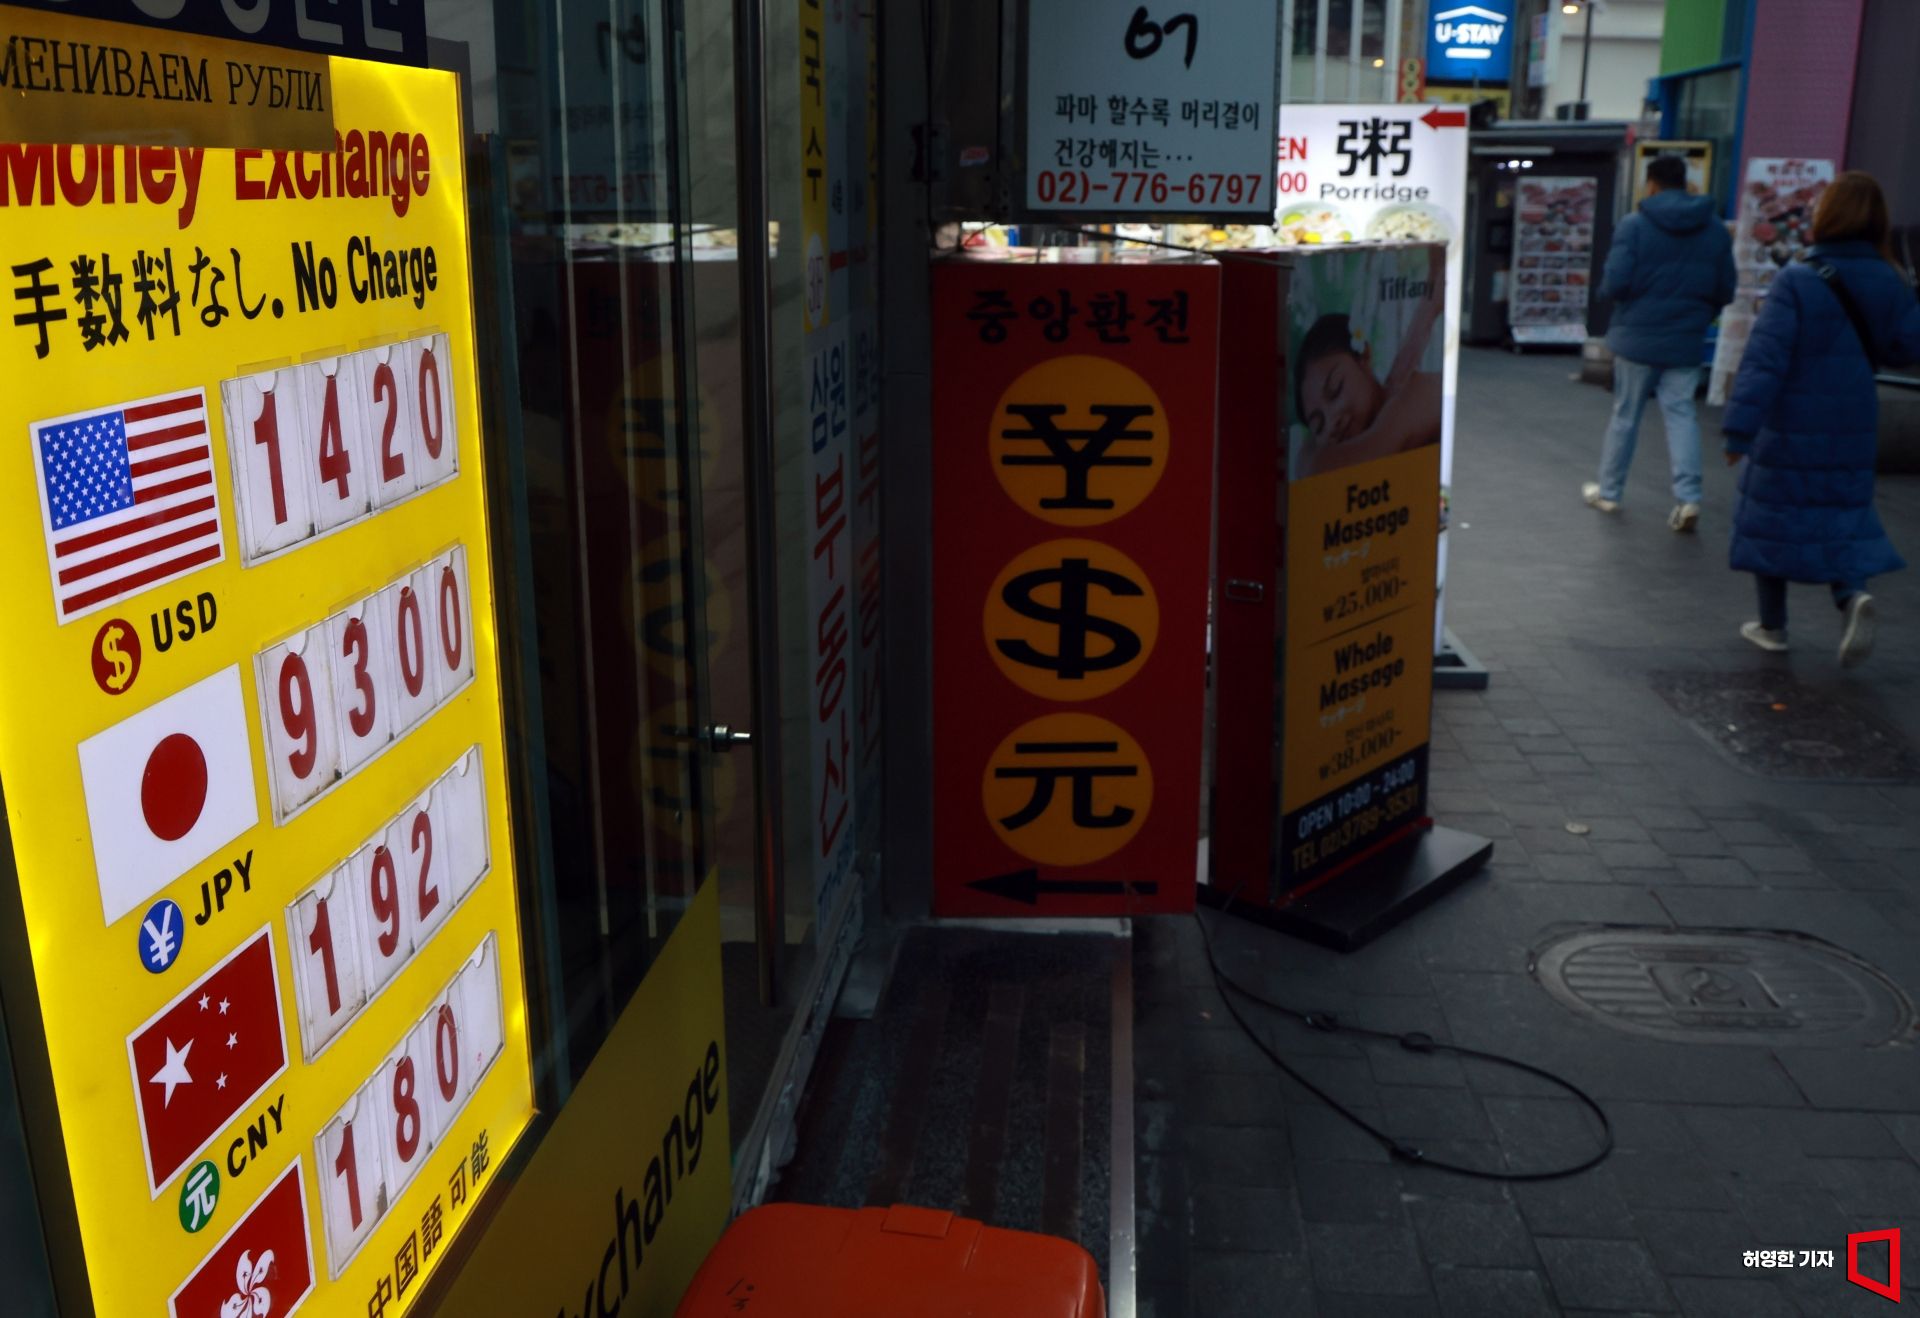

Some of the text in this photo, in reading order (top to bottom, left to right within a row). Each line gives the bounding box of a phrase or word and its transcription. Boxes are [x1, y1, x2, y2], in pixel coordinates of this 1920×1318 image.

[1435, 22, 1504, 45] U-STAY
[226, 62, 325, 111] РУБЛИ
[1055, 94, 1259, 131] 파마 할수록 머리결이
[1337, 118, 1412, 176] 粥
[0, 129, 430, 229] Money Exchange
[1038, 171, 1262, 204] 02)-776-6797
[1277, 172, 1307, 193] 00
[1320, 183, 1429, 202] Porridge
[291, 235, 438, 313] No Charge
[966, 288, 1190, 343] 중앙환전
[254, 348, 443, 526] 1420
[1347, 480, 1390, 512] Foot
[1324, 507, 1409, 549] Massage
[151, 591, 218, 653] USD
[279, 565, 462, 780] 9300
[1334, 631, 1393, 675] Whole
[1320, 657, 1405, 711] Massage
[995, 742, 1138, 831] 元
[1298, 801, 1335, 840] OPEN
[194, 850, 254, 926] JPY
[309, 810, 440, 1017] 192
[227, 1094, 285, 1179] CNY
[336, 1004, 458, 1232] 180
[182, 1166, 218, 1231] 元
